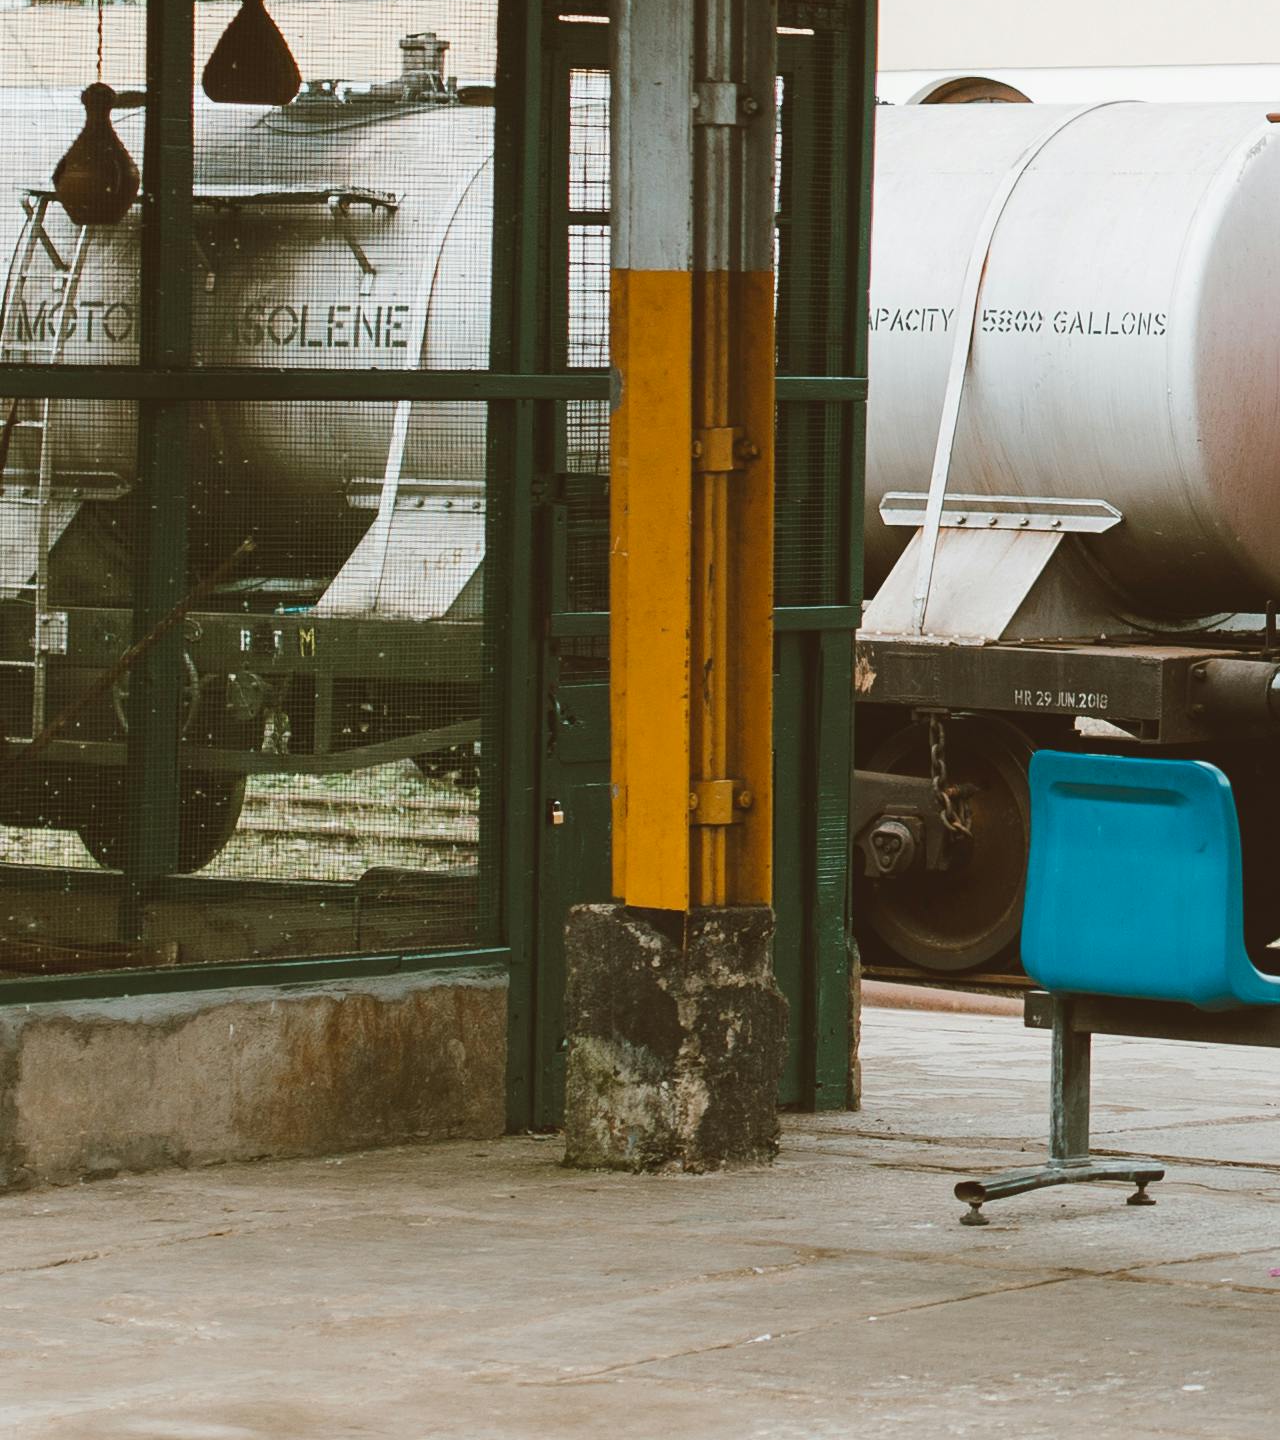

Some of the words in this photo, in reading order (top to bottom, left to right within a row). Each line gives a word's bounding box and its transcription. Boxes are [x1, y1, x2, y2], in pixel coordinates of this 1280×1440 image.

[17, 300, 140, 343] MOTO
[982, 309, 1043, 333] 5800
[1053, 310, 1167, 336] GALLONS
[1013, 689, 1033, 707] HR
[1036, 690, 1053, 707] 29
